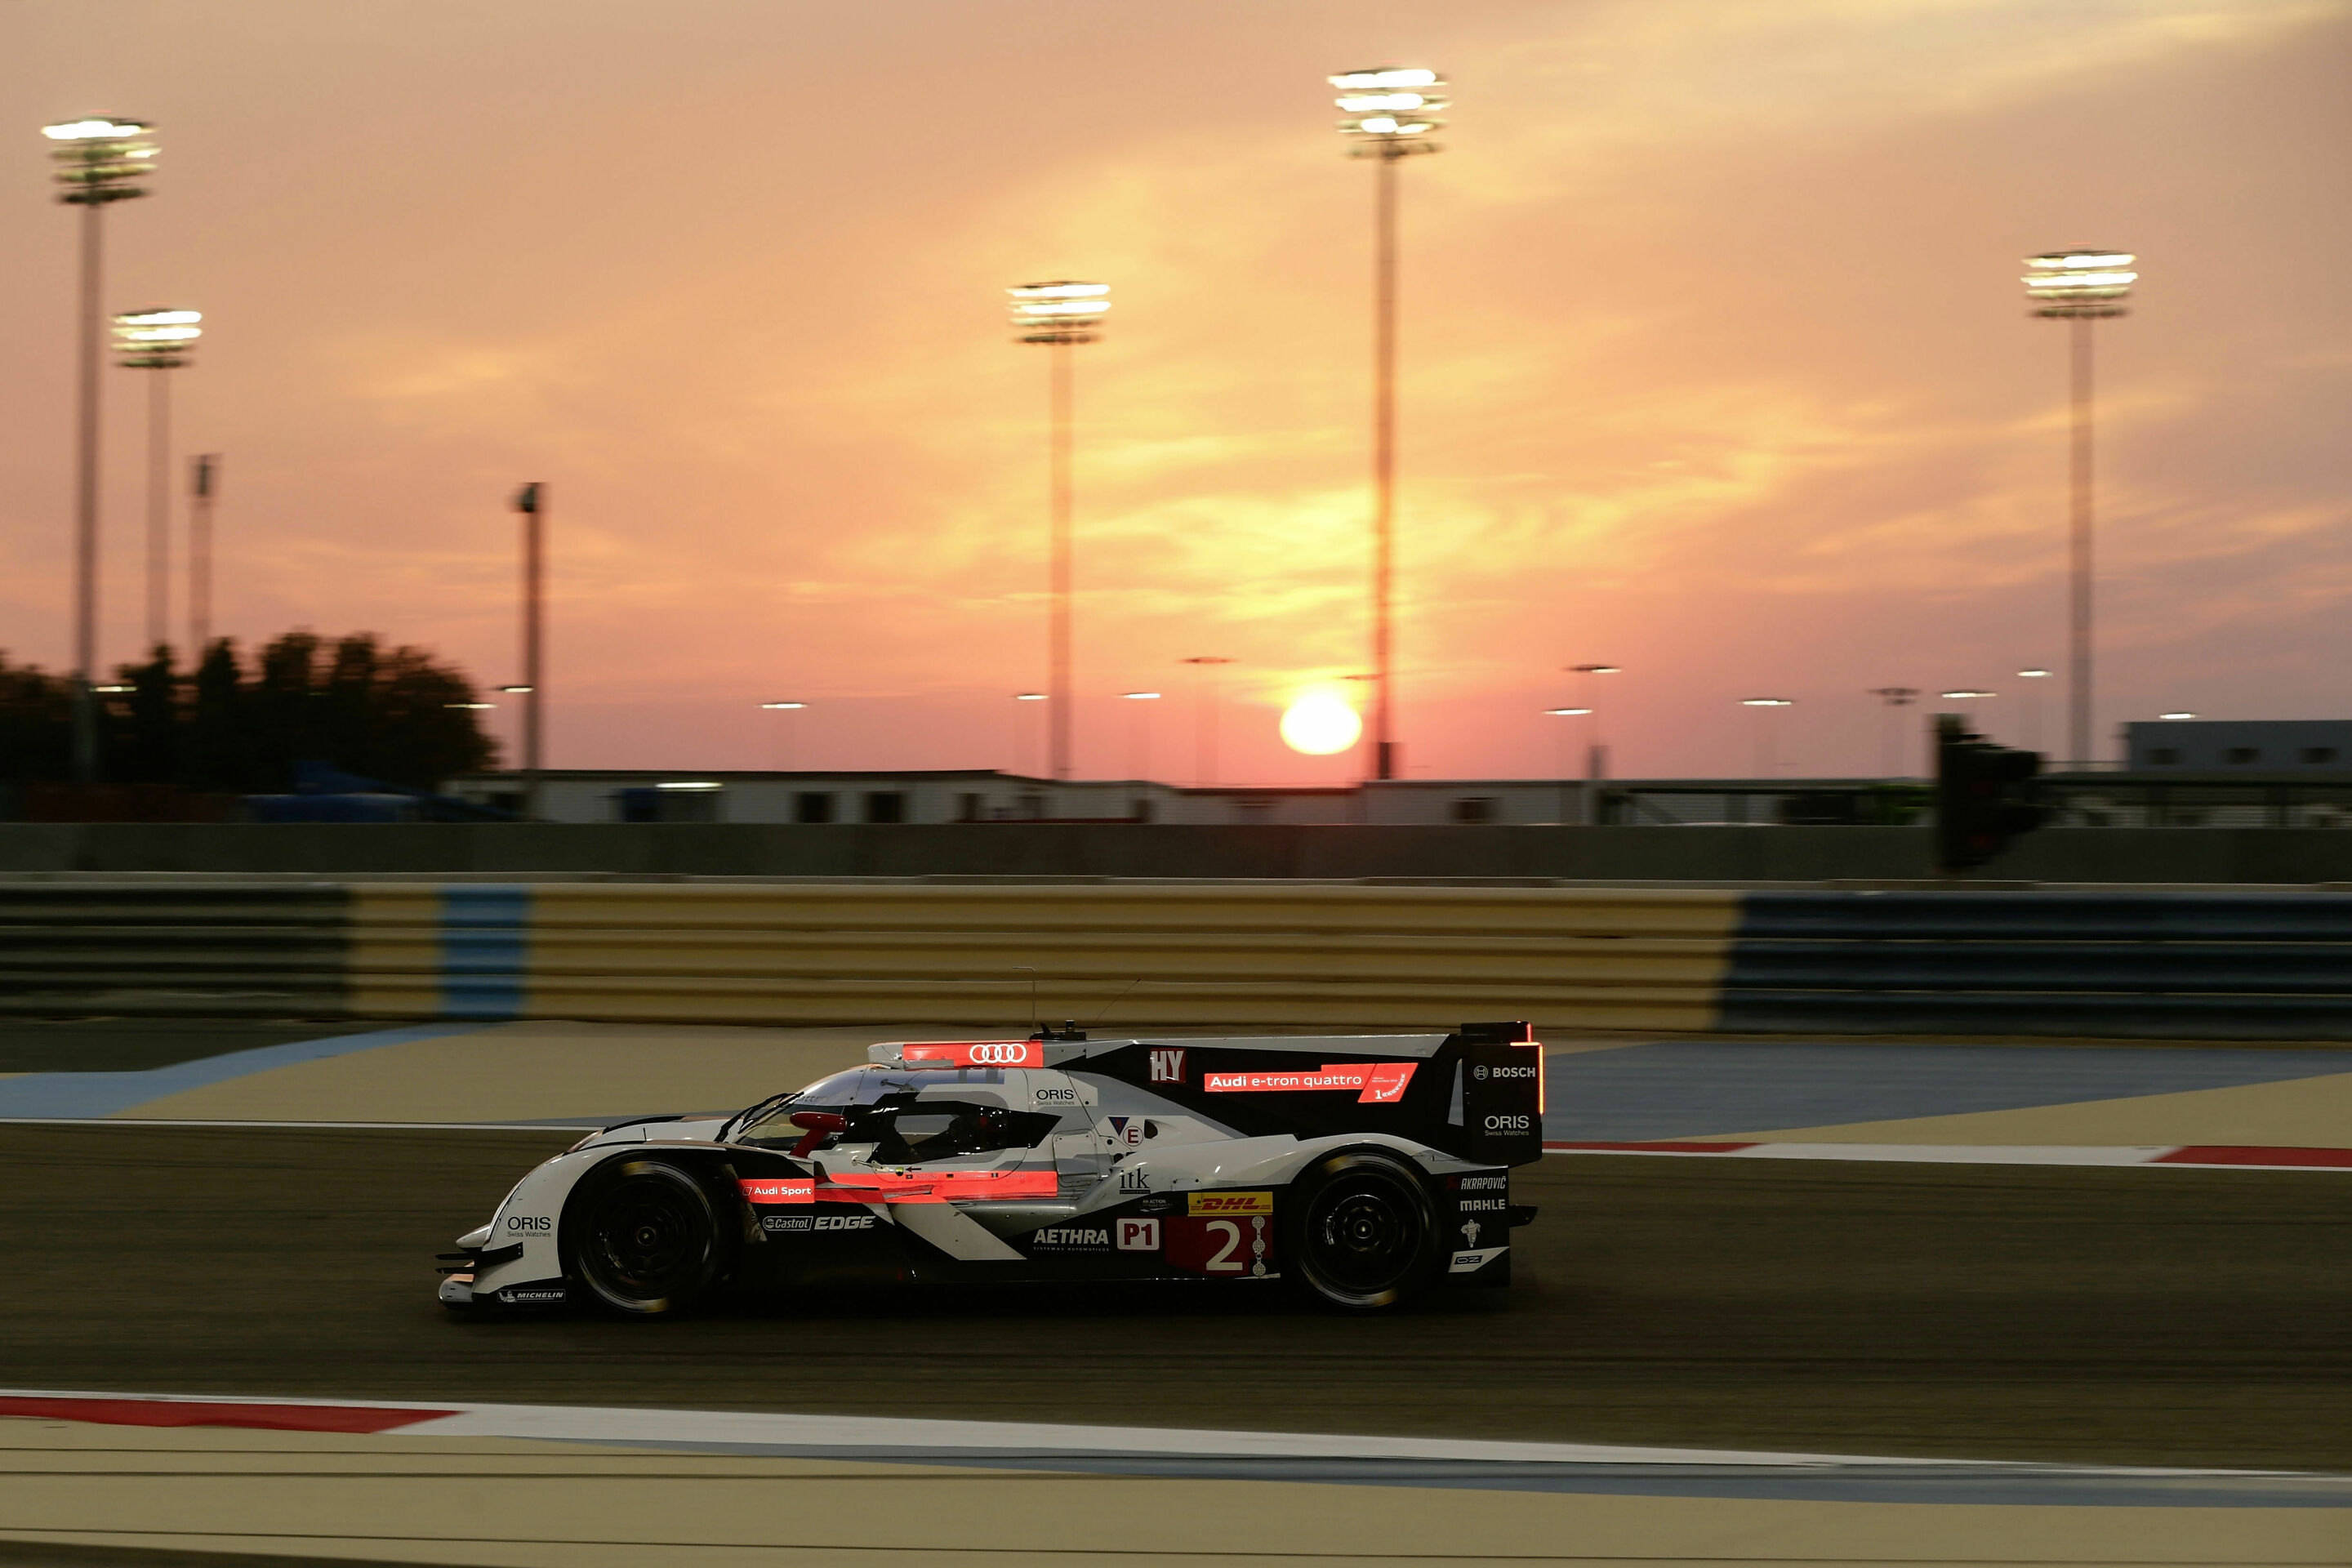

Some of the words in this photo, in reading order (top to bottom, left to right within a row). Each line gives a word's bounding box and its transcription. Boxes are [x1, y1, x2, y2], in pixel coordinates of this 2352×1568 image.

[1151, 1050, 1184, 1081] HY
[1493, 1067, 1535, 1077] BOSCH
[1210, 1076, 1247, 1087] Audi
[1251, 1076, 1298, 1086] e-tron
[1303, 1076, 1362, 1088] quattro
[1036, 1089, 1074, 1100] ORIS
[1374, 1089, 1383, 1099] 1
[1485, 1116, 1530, 1129] ORIS
[1128, 1129, 1139, 1143] E
[1120, 1167, 1150, 1189] itk
[1460, 1176, 1506, 1190] AKRAPOVIČ
[754, 1187, 778, 1196] Audi
[781, 1187, 812, 1196] Sport
[1202, 1197, 1260, 1210] DHL
[1460, 1199, 1506, 1211] MAHLE
[507, 1216, 551, 1231] ORIS
[775, 1218, 808, 1228] Castrol
[814, 1215, 876, 1231] EDGE
[1033, 1229, 1109, 1245] AETHRA
[1124, 1223, 1152, 1245] P1
[1206, 1220, 1243, 1271] 2
